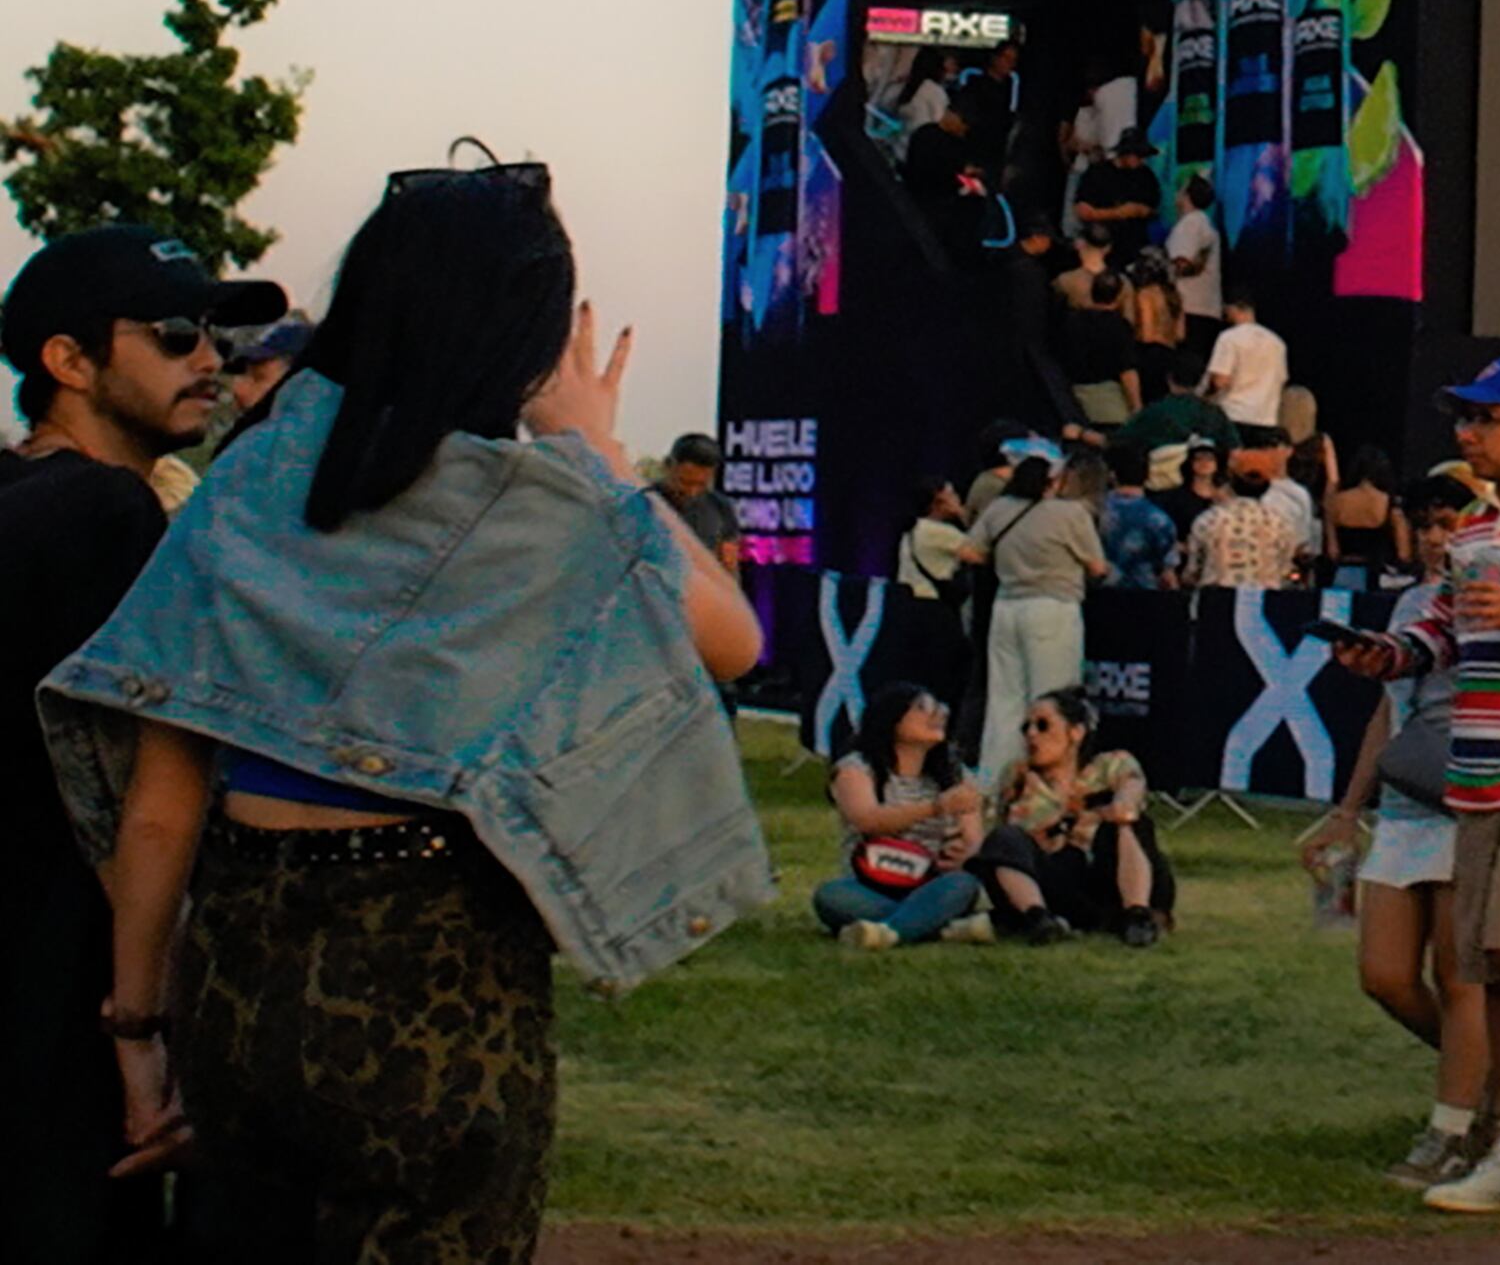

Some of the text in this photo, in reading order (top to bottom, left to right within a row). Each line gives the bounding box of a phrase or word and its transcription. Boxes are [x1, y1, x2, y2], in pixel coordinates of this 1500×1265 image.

[921, 10, 1010, 40] AXE
[1295, 14, 1341, 46] AXE
[726, 419, 817, 457] HUELE
[814, 569, 887, 757] X
[1097, 662, 1151, 701] AXE
[1219, 586, 1353, 802] X
